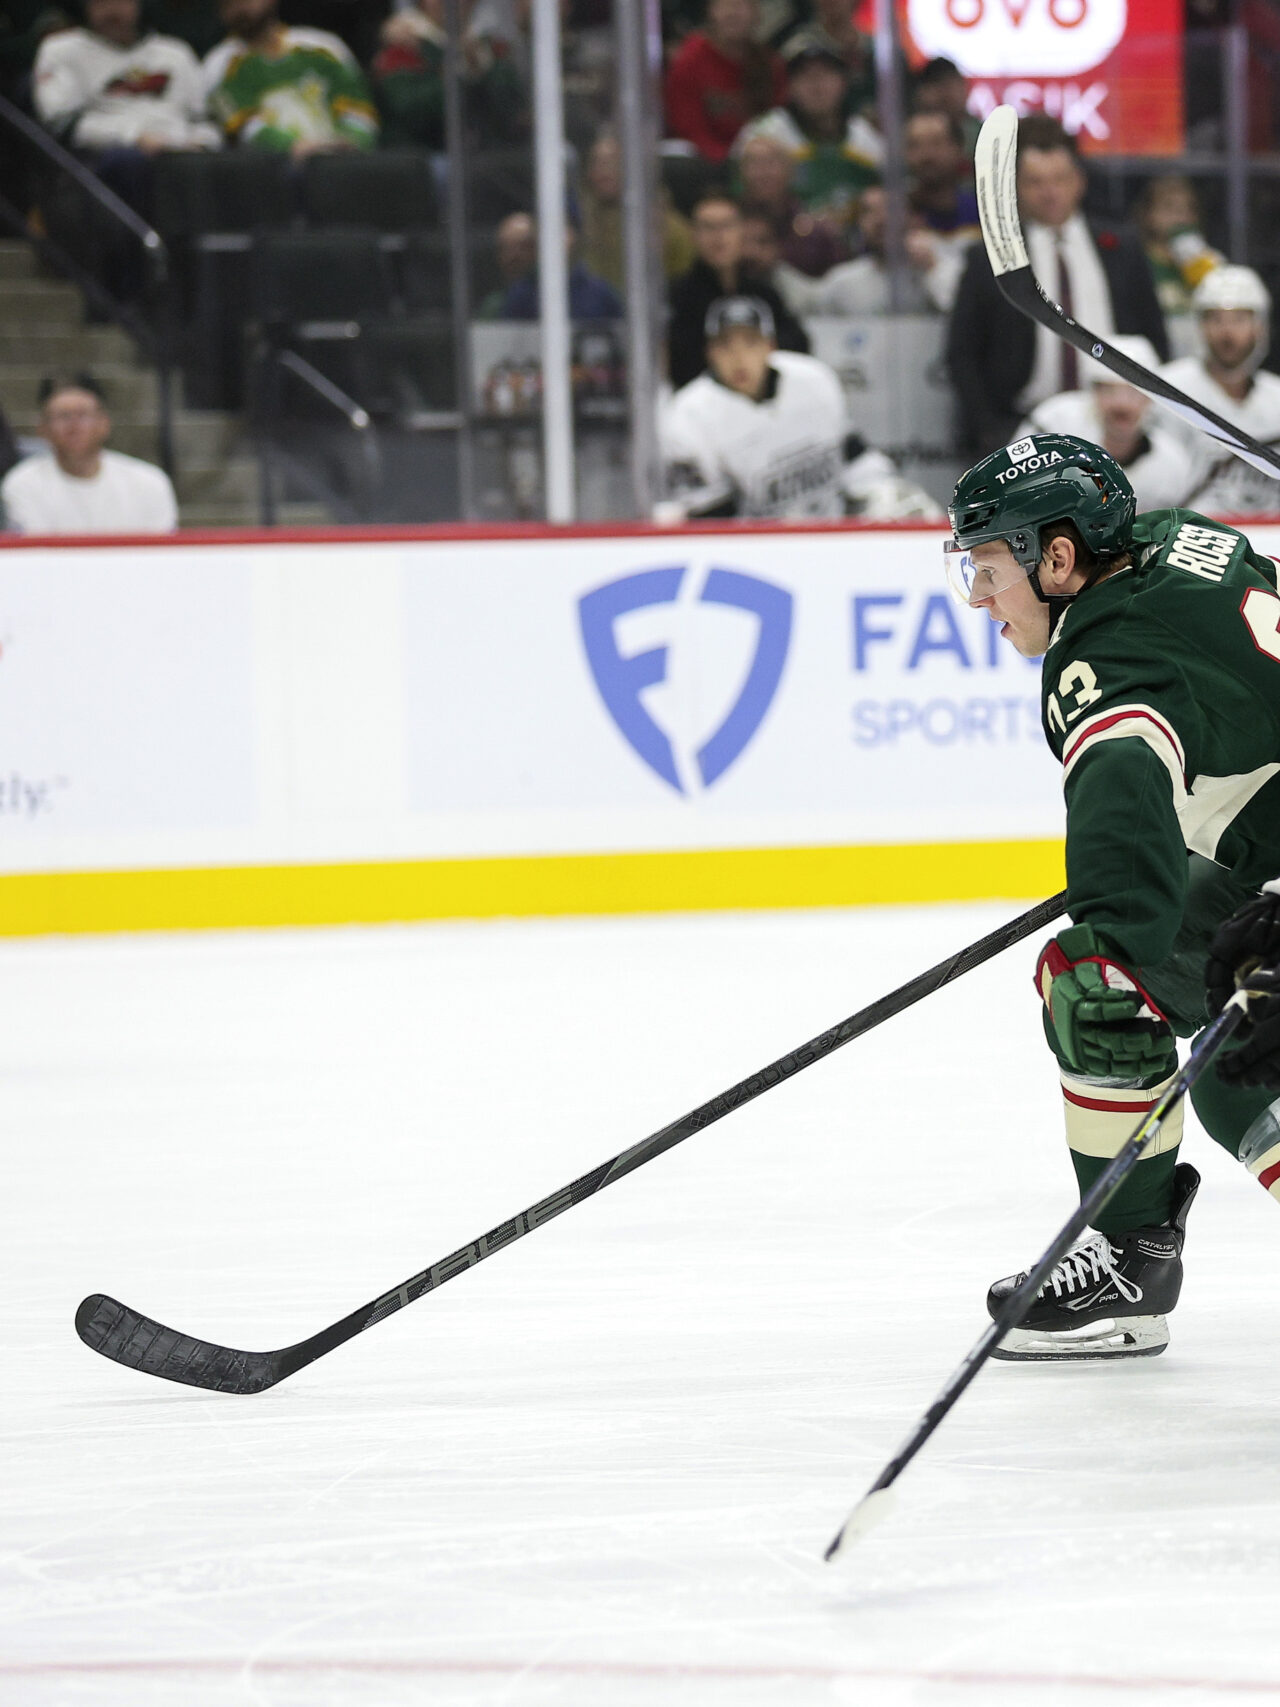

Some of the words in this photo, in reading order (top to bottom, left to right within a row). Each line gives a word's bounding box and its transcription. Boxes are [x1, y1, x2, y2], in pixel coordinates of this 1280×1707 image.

[967, 82, 1111, 140] ASIK
[995, 450, 1063, 485] TOYOTA
[1165, 523, 1240, 582] ROSSI
[374, 1186, 573, 1307] TRUE
[1137, 1239, 1174, 1251] CATALYST
[1099, 1293, 1119, 1303] PRO
